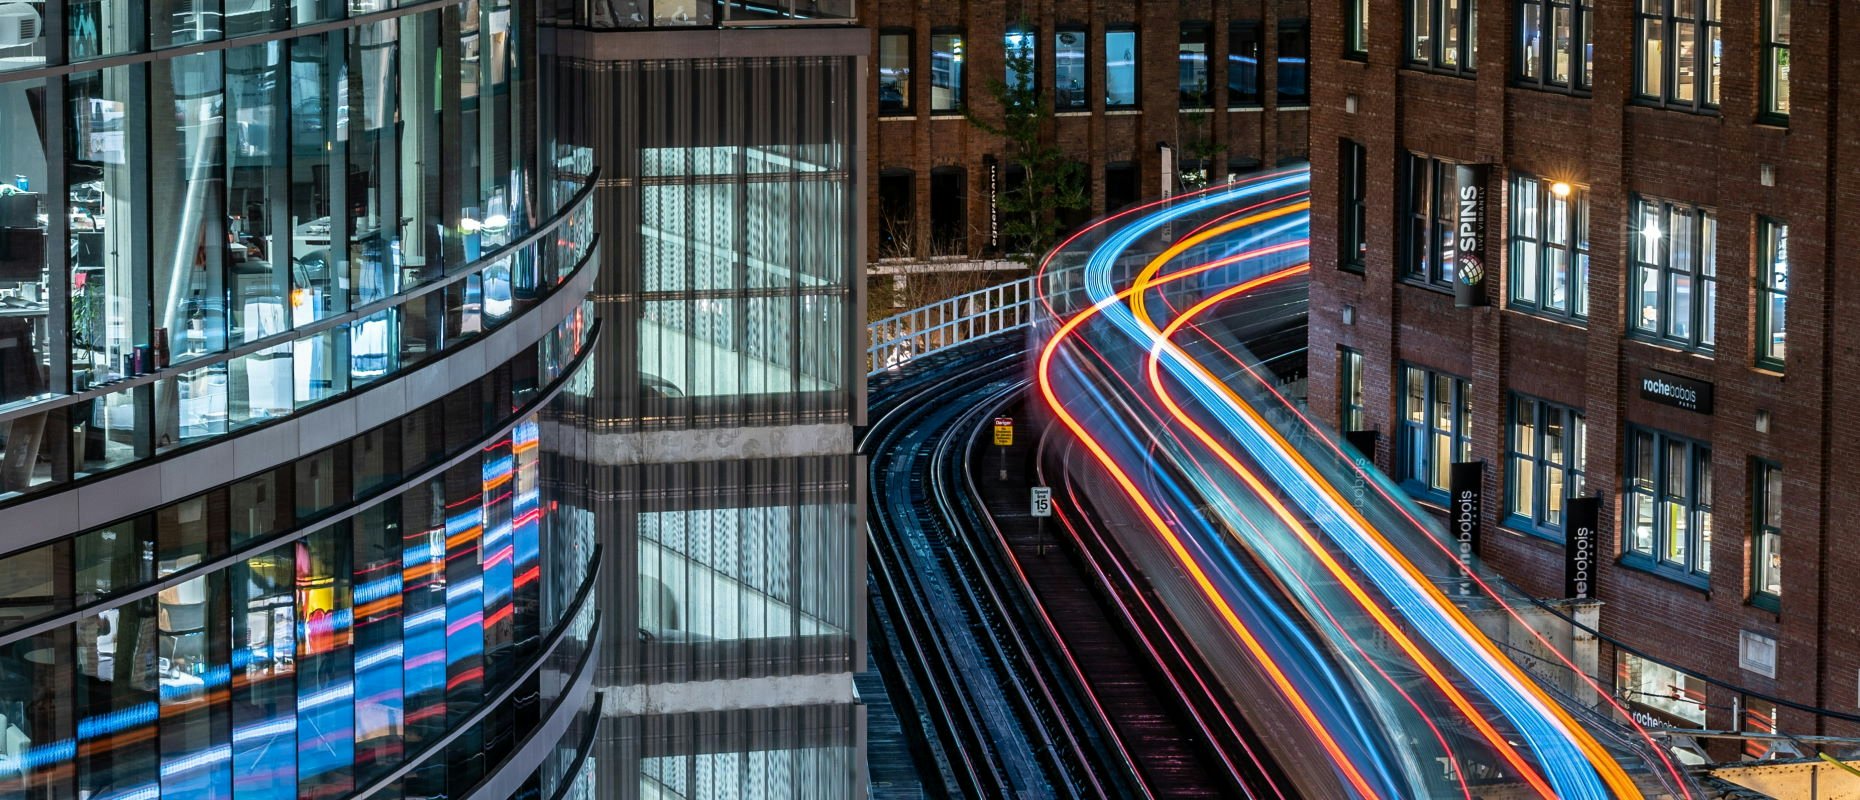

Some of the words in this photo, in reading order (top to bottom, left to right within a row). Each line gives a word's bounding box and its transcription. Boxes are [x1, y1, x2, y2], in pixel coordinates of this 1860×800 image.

[1460, 185, 1478, 252] SPINS
[1643, 379, 1696, 403] rochebobois
[1678, 401, 1696, 410] PARIS
[1034, 499, 1048, 510] 15
